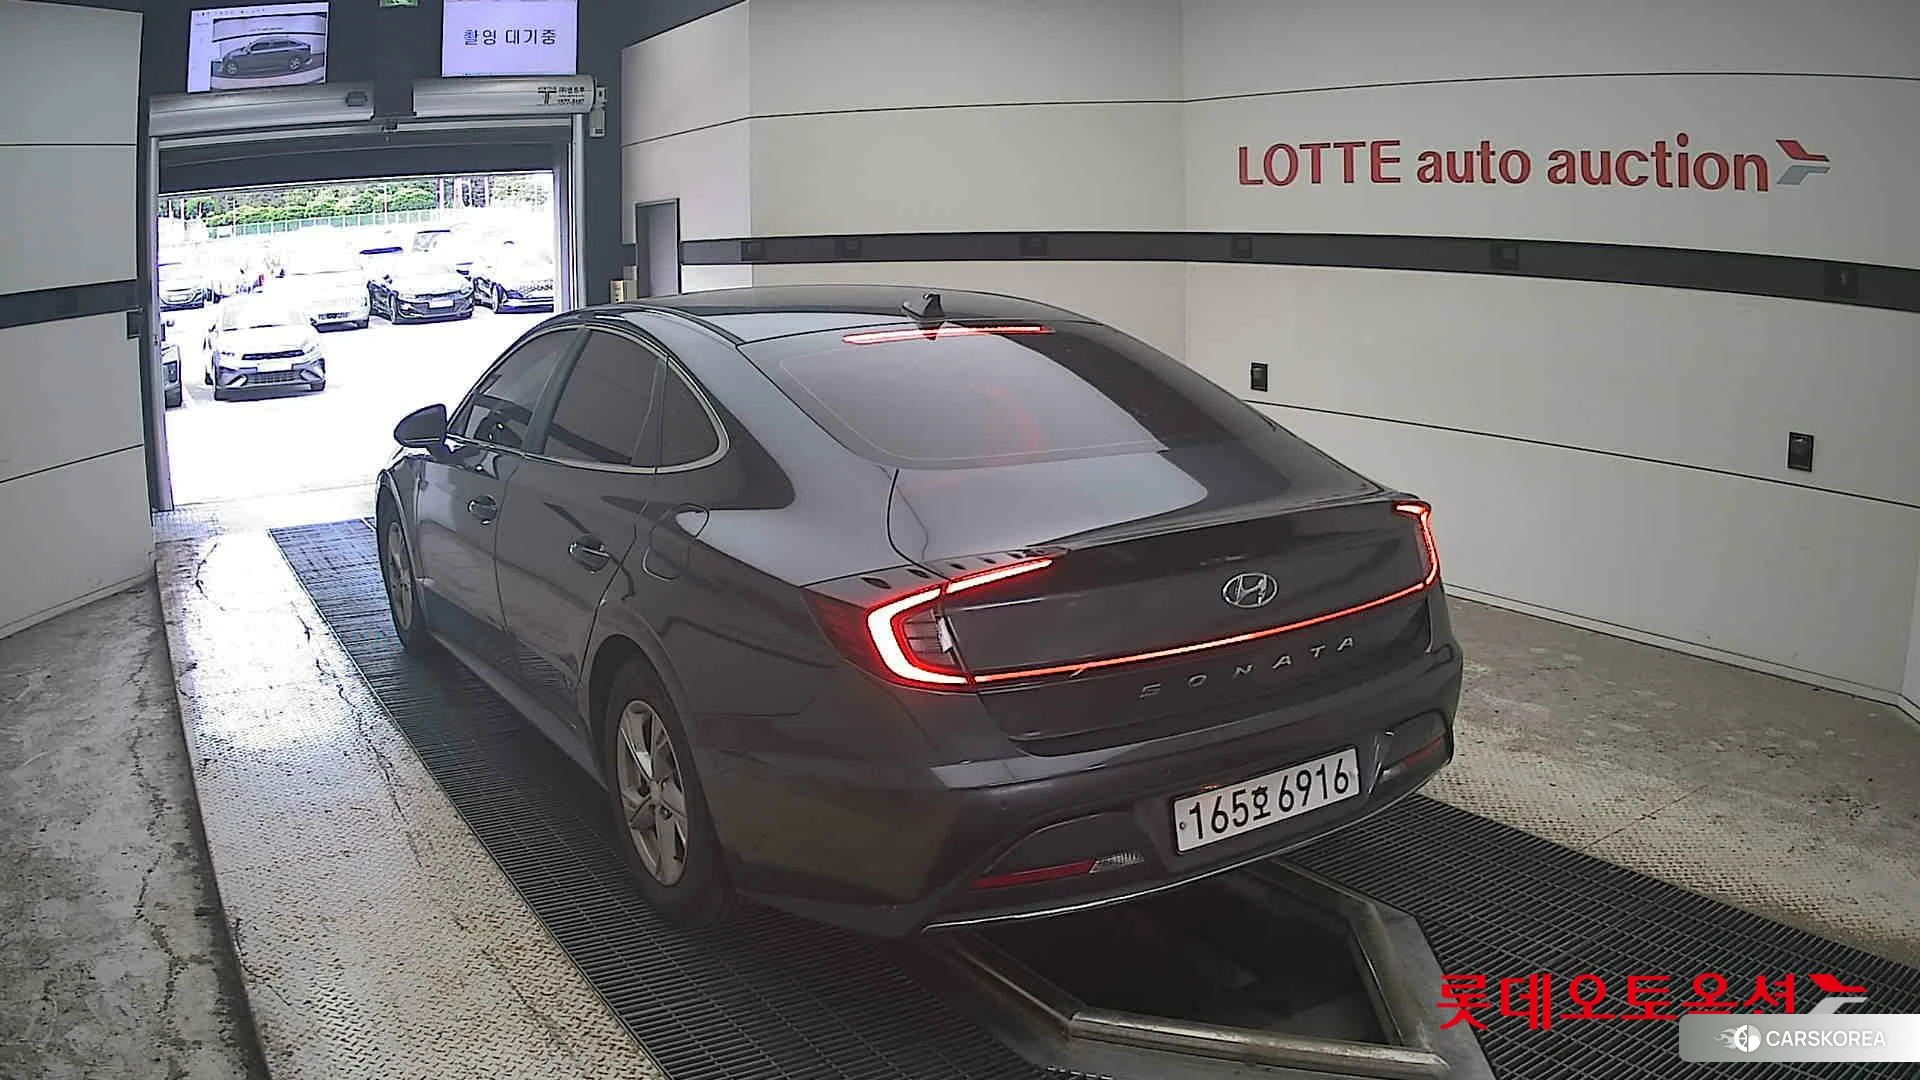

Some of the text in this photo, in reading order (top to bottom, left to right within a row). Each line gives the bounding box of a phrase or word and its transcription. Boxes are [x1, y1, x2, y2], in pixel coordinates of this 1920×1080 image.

[505, 29, 557, 46] 대기중
[1238, 132, 1769, 192] LOTTE auto auction
[1139, 637, 1354, 699] SONATA
